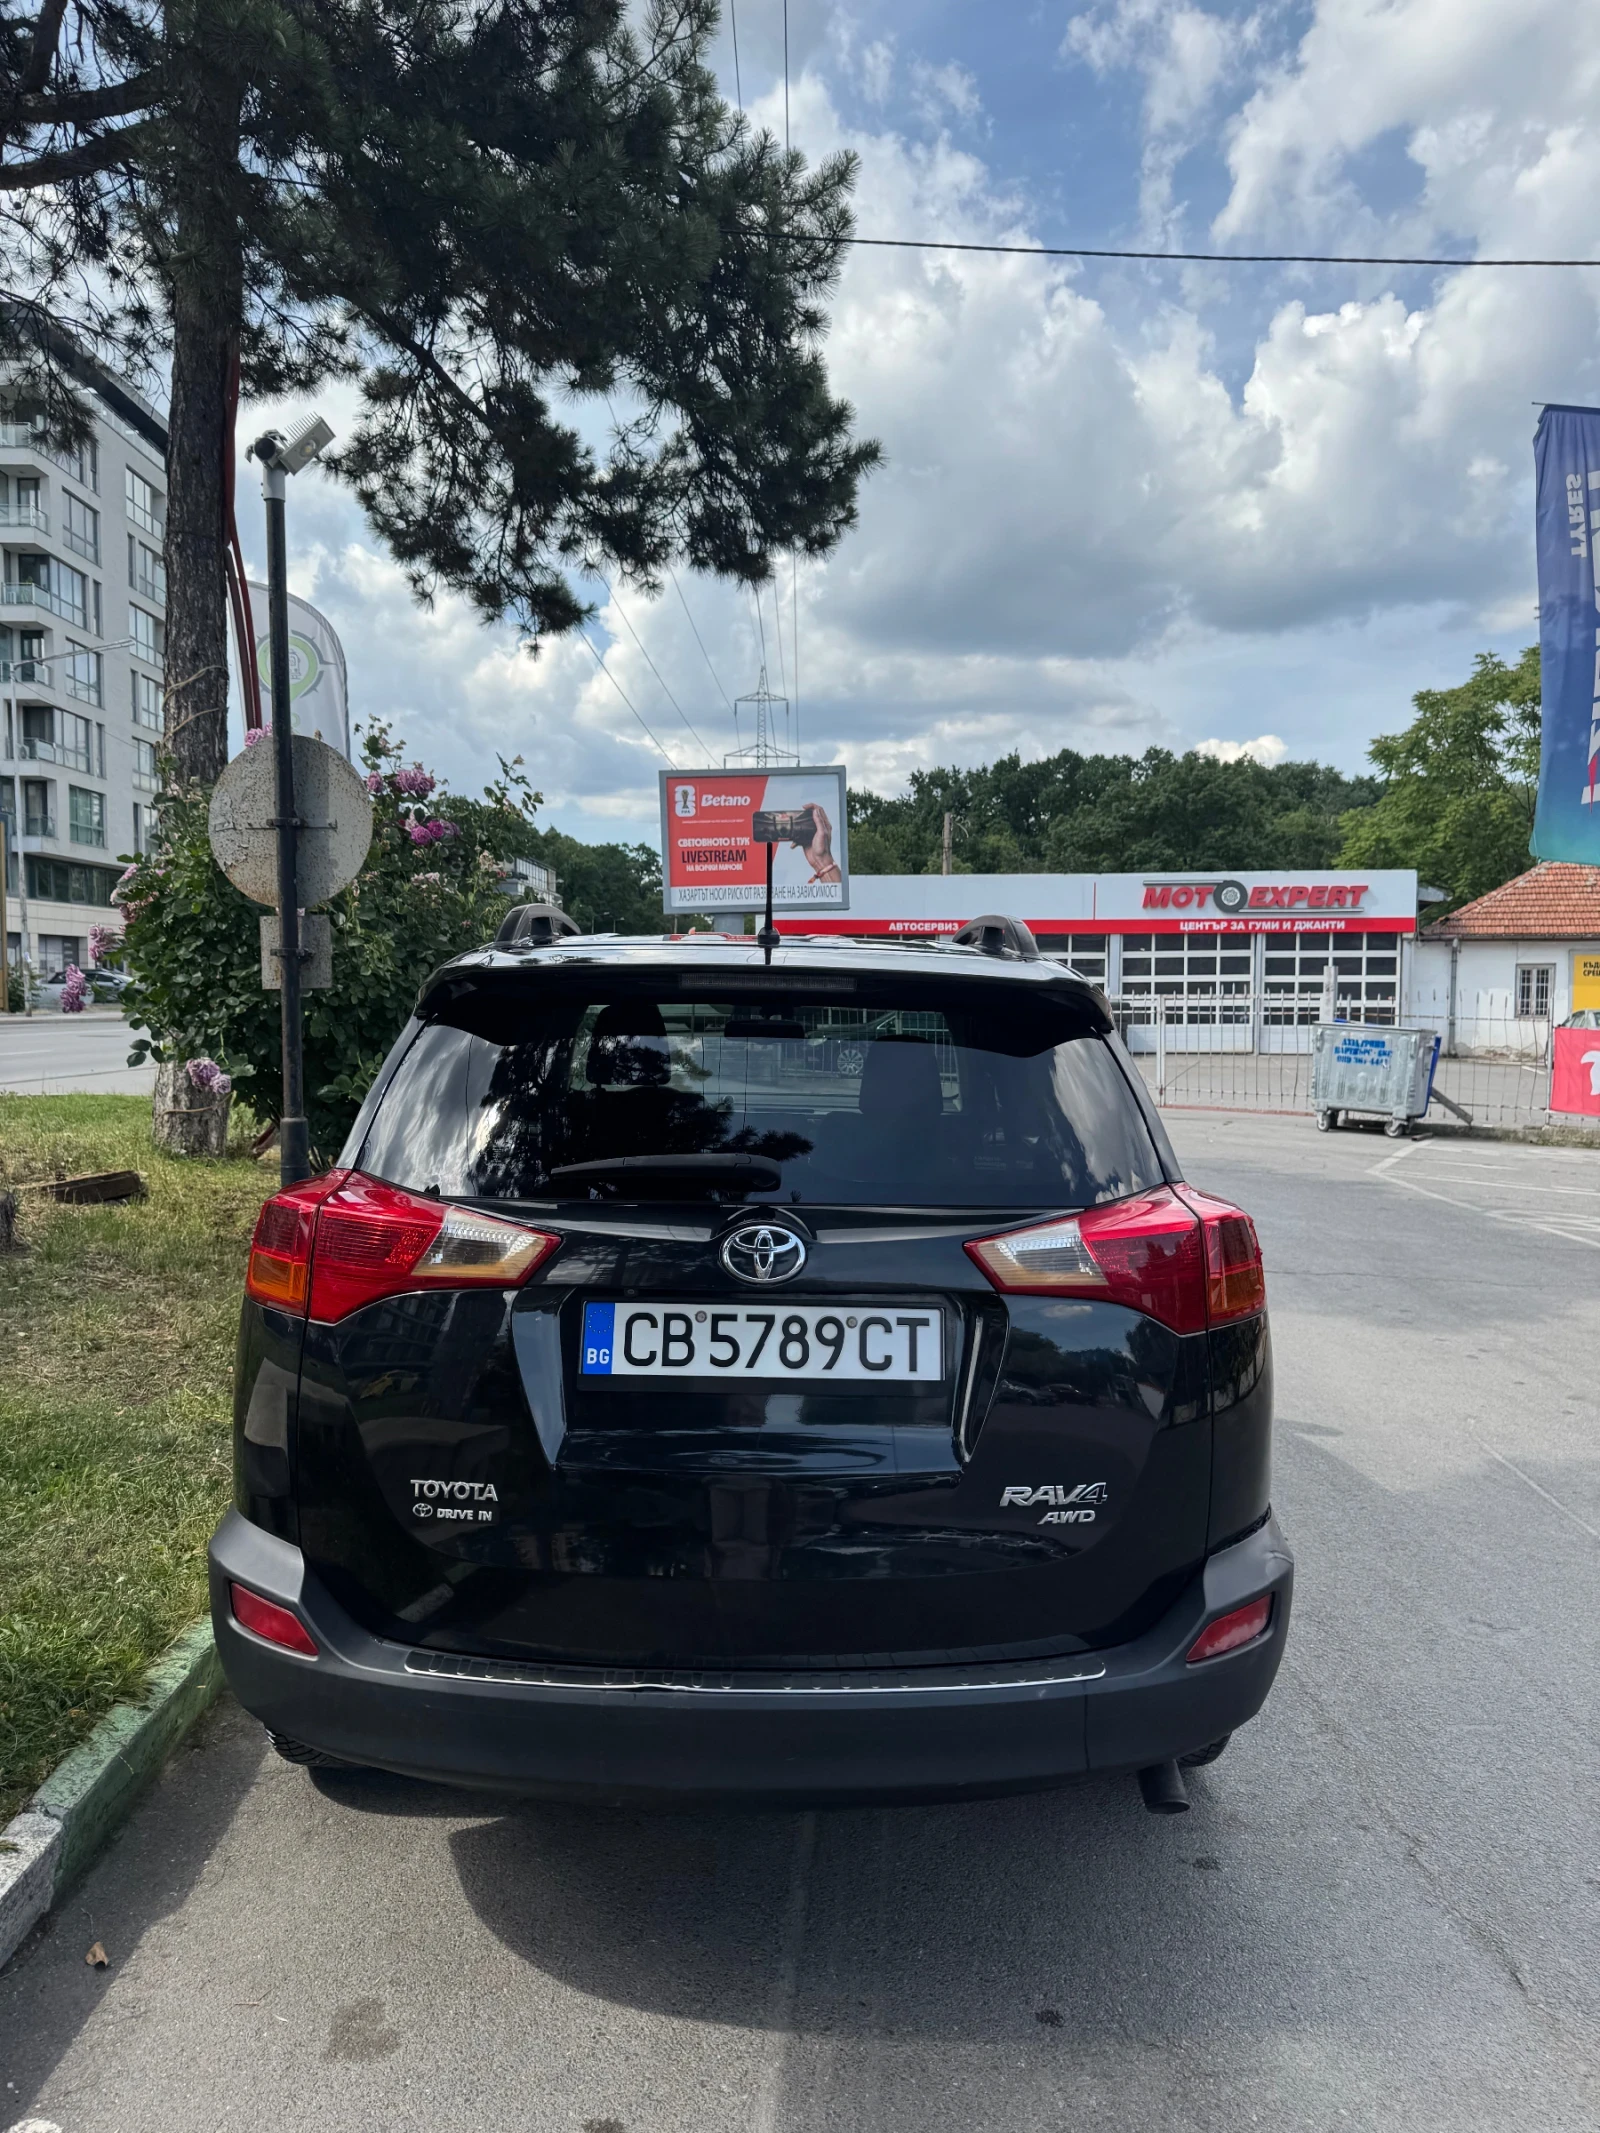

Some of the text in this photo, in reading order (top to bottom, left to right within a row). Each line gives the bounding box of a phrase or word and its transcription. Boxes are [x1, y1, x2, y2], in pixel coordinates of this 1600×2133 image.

[701, 793, 751, 807] Betano
[678, 837, 730, 847] СВЕТОВНОТО
[736, 837, 750, 846] ТУК
[681, 849, 747, 863] LIVESTREAM
[686, 864, 694, 872] НА
[678, 887, 709, 902] ХАЗАРТЪТ
[710, 887, 727, 901] НОСИ
[728, 886, 744, 900] РИСК
[745, 886, 753, 899] ОТ
[787, 885, 796, 898] НА
[797, 884, 838, 898] ЗАВИСИМОСТ
[1248, 885, 1369, 907] EXPERT
[888, 922, 959, 932] АВТОСЕРВИЗ
[1180, 920, 1345, 932] ЦЕНТЪР ЗА ГУМИ И ДЖАНТИ
[1583, 961, 1600, 969] КЪД
[623, 1312, 931, 1373] CB 5789 CT
[586, 1347, 611, 1365] BG
[410, 1479, 499, 1502] TOYOTA
[999, 1481, 1109, 1507] RAV4
[436, 1507, 493, 1522] DRIVE IN
[1036, 1509, 1097, 1525] AWD
